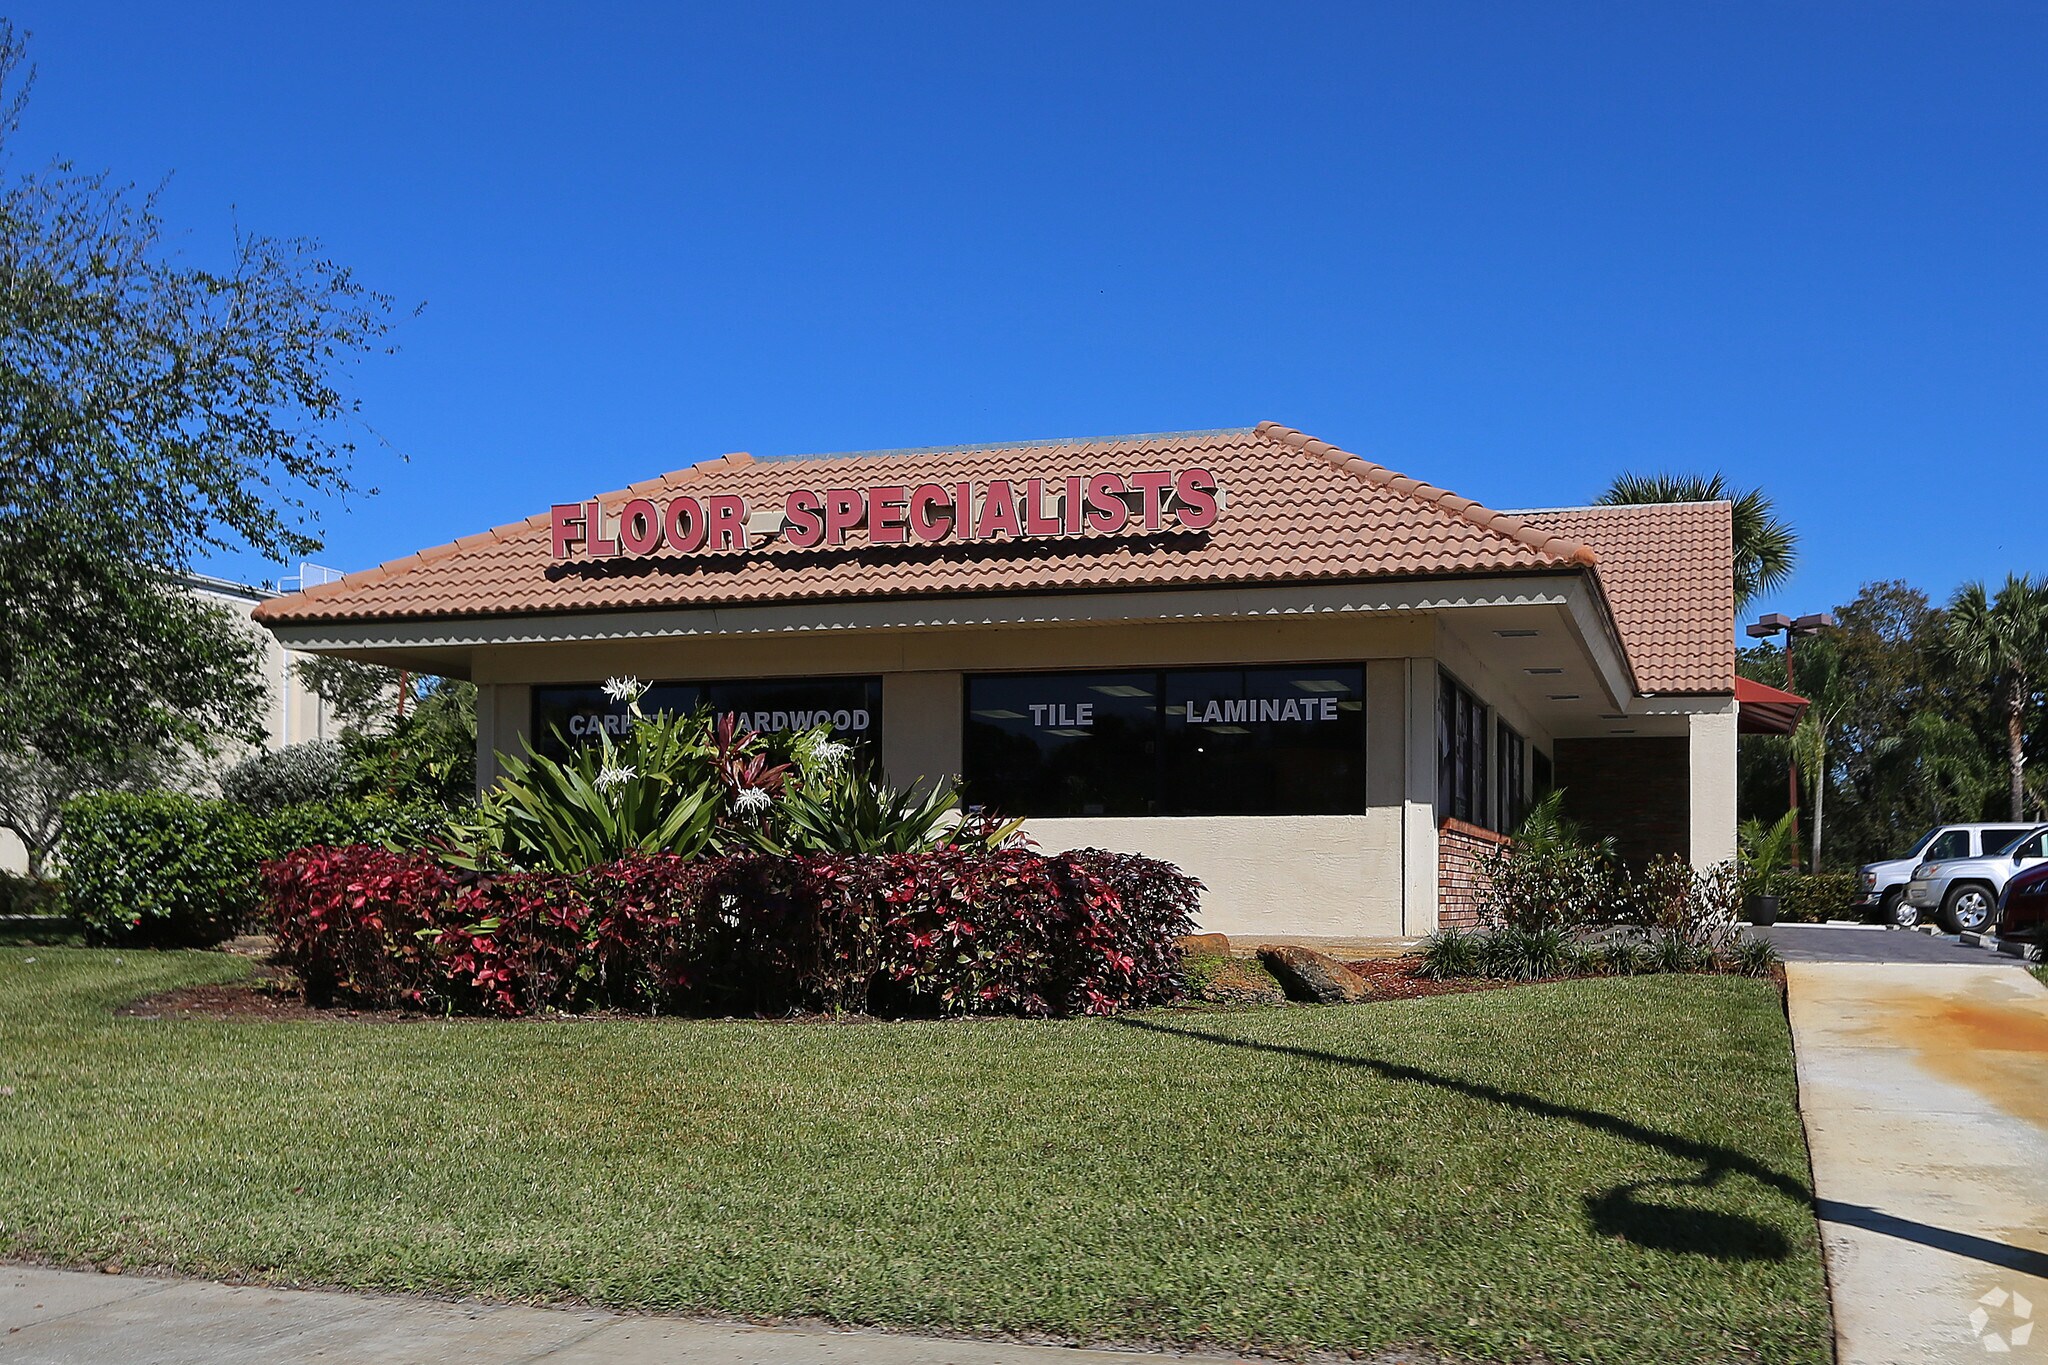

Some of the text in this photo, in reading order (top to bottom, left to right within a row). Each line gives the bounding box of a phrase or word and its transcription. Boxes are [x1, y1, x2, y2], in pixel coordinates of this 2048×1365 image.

[550, 468, 1221, 559] FLOOR SPECIALISTS
[569, 714, 668, 735] CARP
[1028, 697, 1339, 727] TILE LAMINATE
